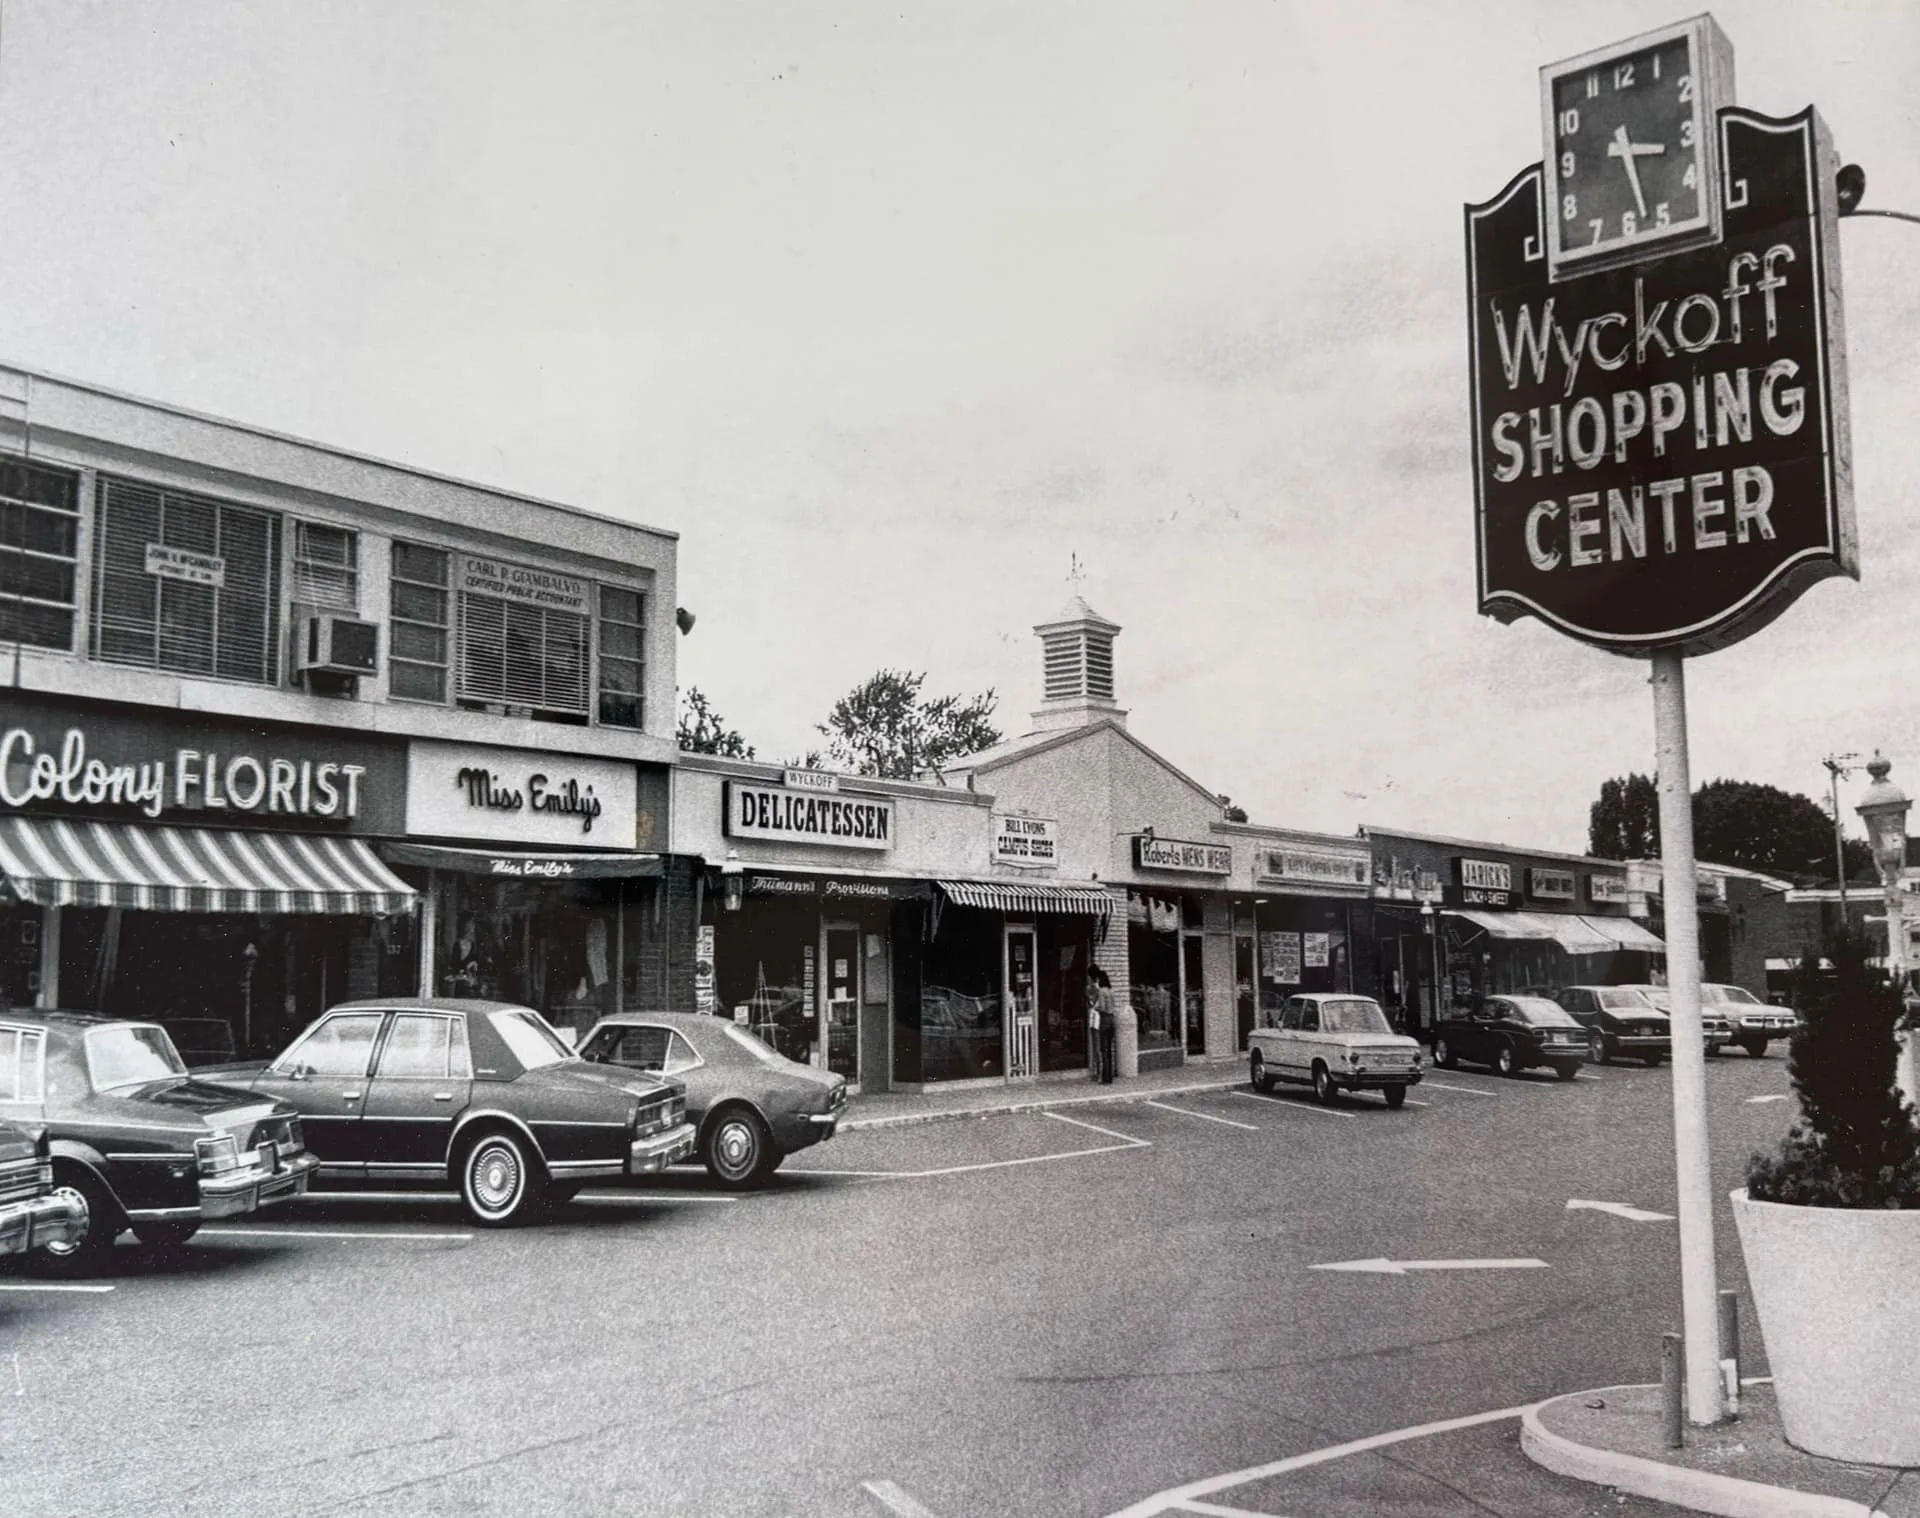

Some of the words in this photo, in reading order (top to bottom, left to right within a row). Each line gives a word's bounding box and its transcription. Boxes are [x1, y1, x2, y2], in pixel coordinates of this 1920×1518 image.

[1587, 73, 1599, 99] 11
[1613, 63, 1635, 90] 12
[1677, 75, 1692, 103] 2
[1559, 109, 1579, 136] 10
[1680, 120, 1694, 148] 3
[1562, 152, 1576, 178] 9
[1682, 163, 1696, 190] 4
[1563, 194, 1577, 221] 8
[1656, 202, 1670, 230] 5
[1588, 218, 1604, 247] 7
[1622, 210, 1636, 237] 6
[1490, 244, 1795, 397] Wyckoff
[1491, 358, 1806, 482] SHOPPING
[1525, 465, 1776, 571] CENTER
[467, 560, 497, 578] CARL
[0, 729, 165, 817] Colony
[176, 750, 366, 817] FLORIST
[789, 772, 833, 789] WYCKOFF
[458, 767, 523, 810] Miss
[529, 774, 601, 832] Emily's
[741, 791, 889, 840] DELICATESSEN
[490, 859, 522, 876] Miss
[524, 859, 574, 877] Emily's
